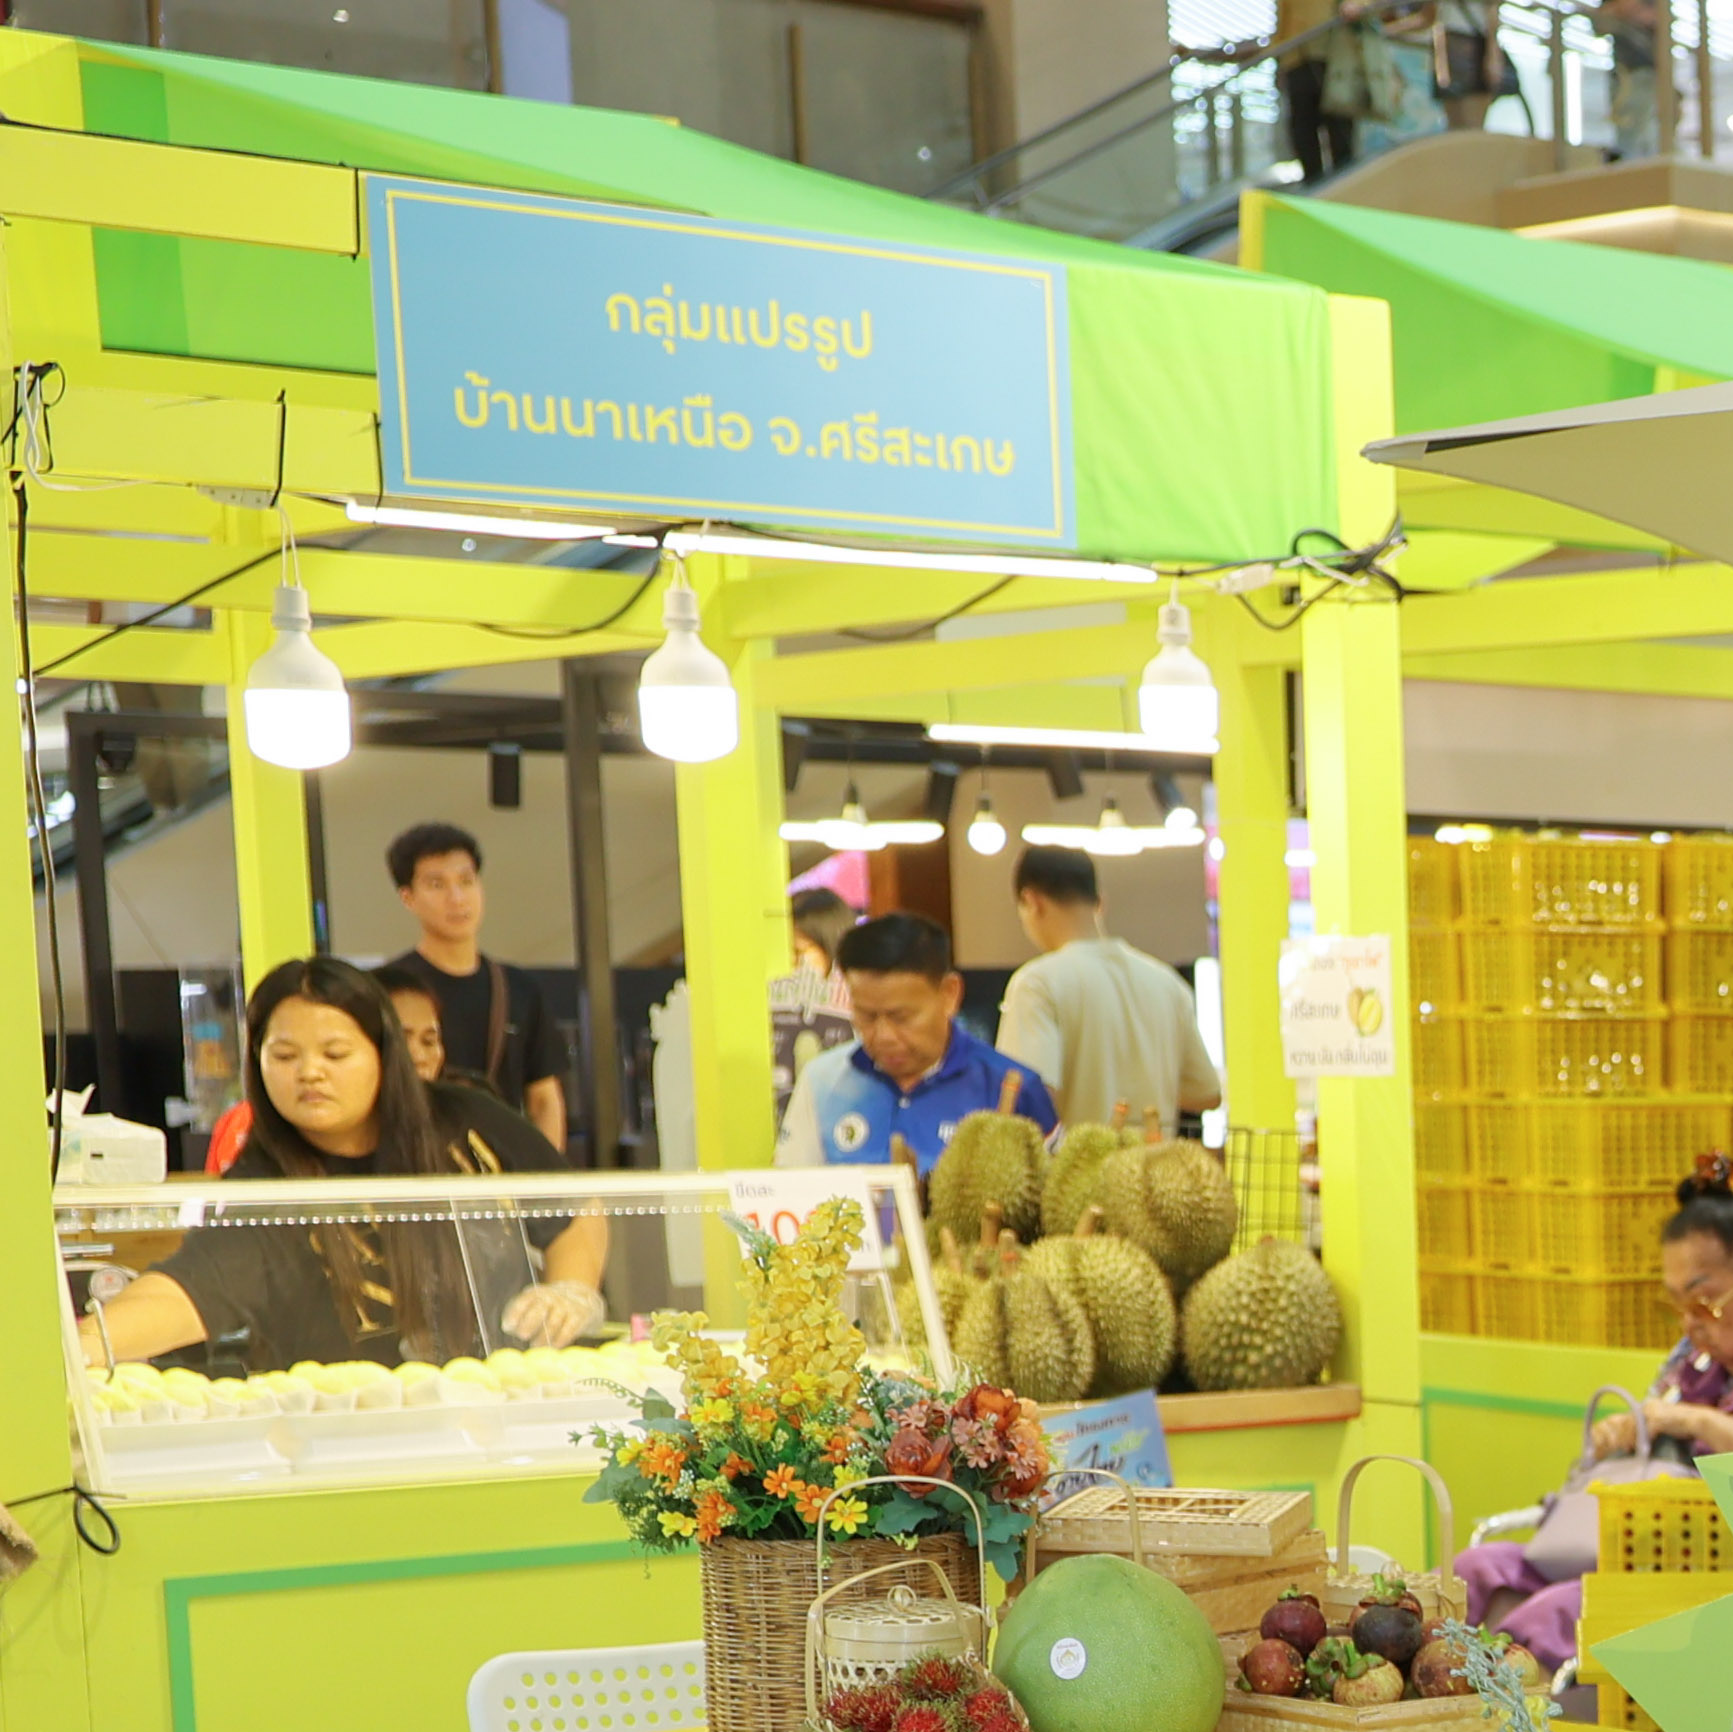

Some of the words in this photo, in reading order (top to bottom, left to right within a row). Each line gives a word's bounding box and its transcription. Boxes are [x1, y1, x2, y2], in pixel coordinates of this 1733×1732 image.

[606, 283, 873, 371] กลุ่มแปรรูป
[454, 371, 752, 451] บ้านนาเหนือ
[769, 411, 1015, 477] จ.ศรีสะเกษ
